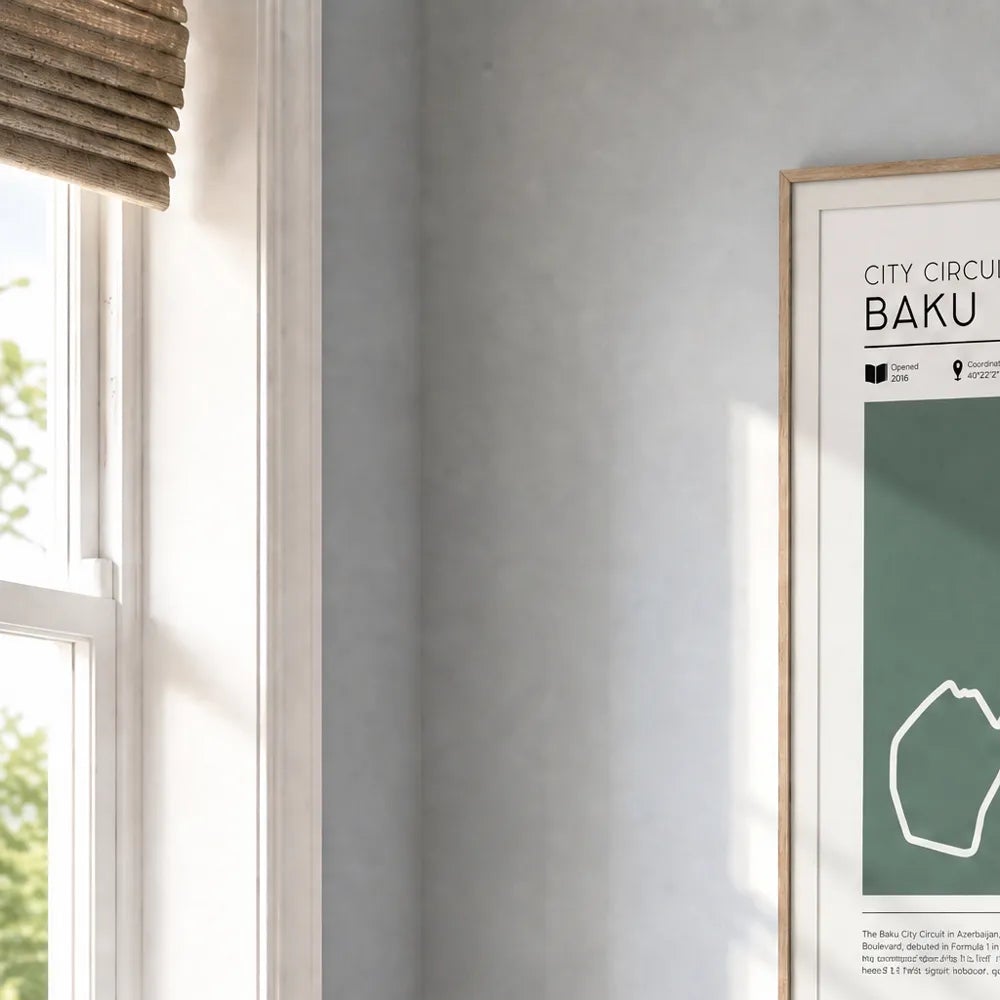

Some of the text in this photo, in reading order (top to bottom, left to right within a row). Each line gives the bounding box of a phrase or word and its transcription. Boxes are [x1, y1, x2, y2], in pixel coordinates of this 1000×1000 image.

[864, 263, 913, 285] CITY
[865, 291, 976, 331] BAKU
[891, 362, 919, 373] Opened
[891, 374, 909, 383] 2016
[862, 930, 877, 938] The
[879, 930, 899, 938] Baku
[901, 930, 917, 940] City
[919, 930, 945, 938] Circuit
[947, 930, 955, 938] in
[957, 930, 1000, 940] Azerbaijan,
[862, 942, 903, 951] Boulevard,
[906, 942, 939, 950] debuted
[942, 942, 949, 950] in
[951, 942, 984, 950] Formula
